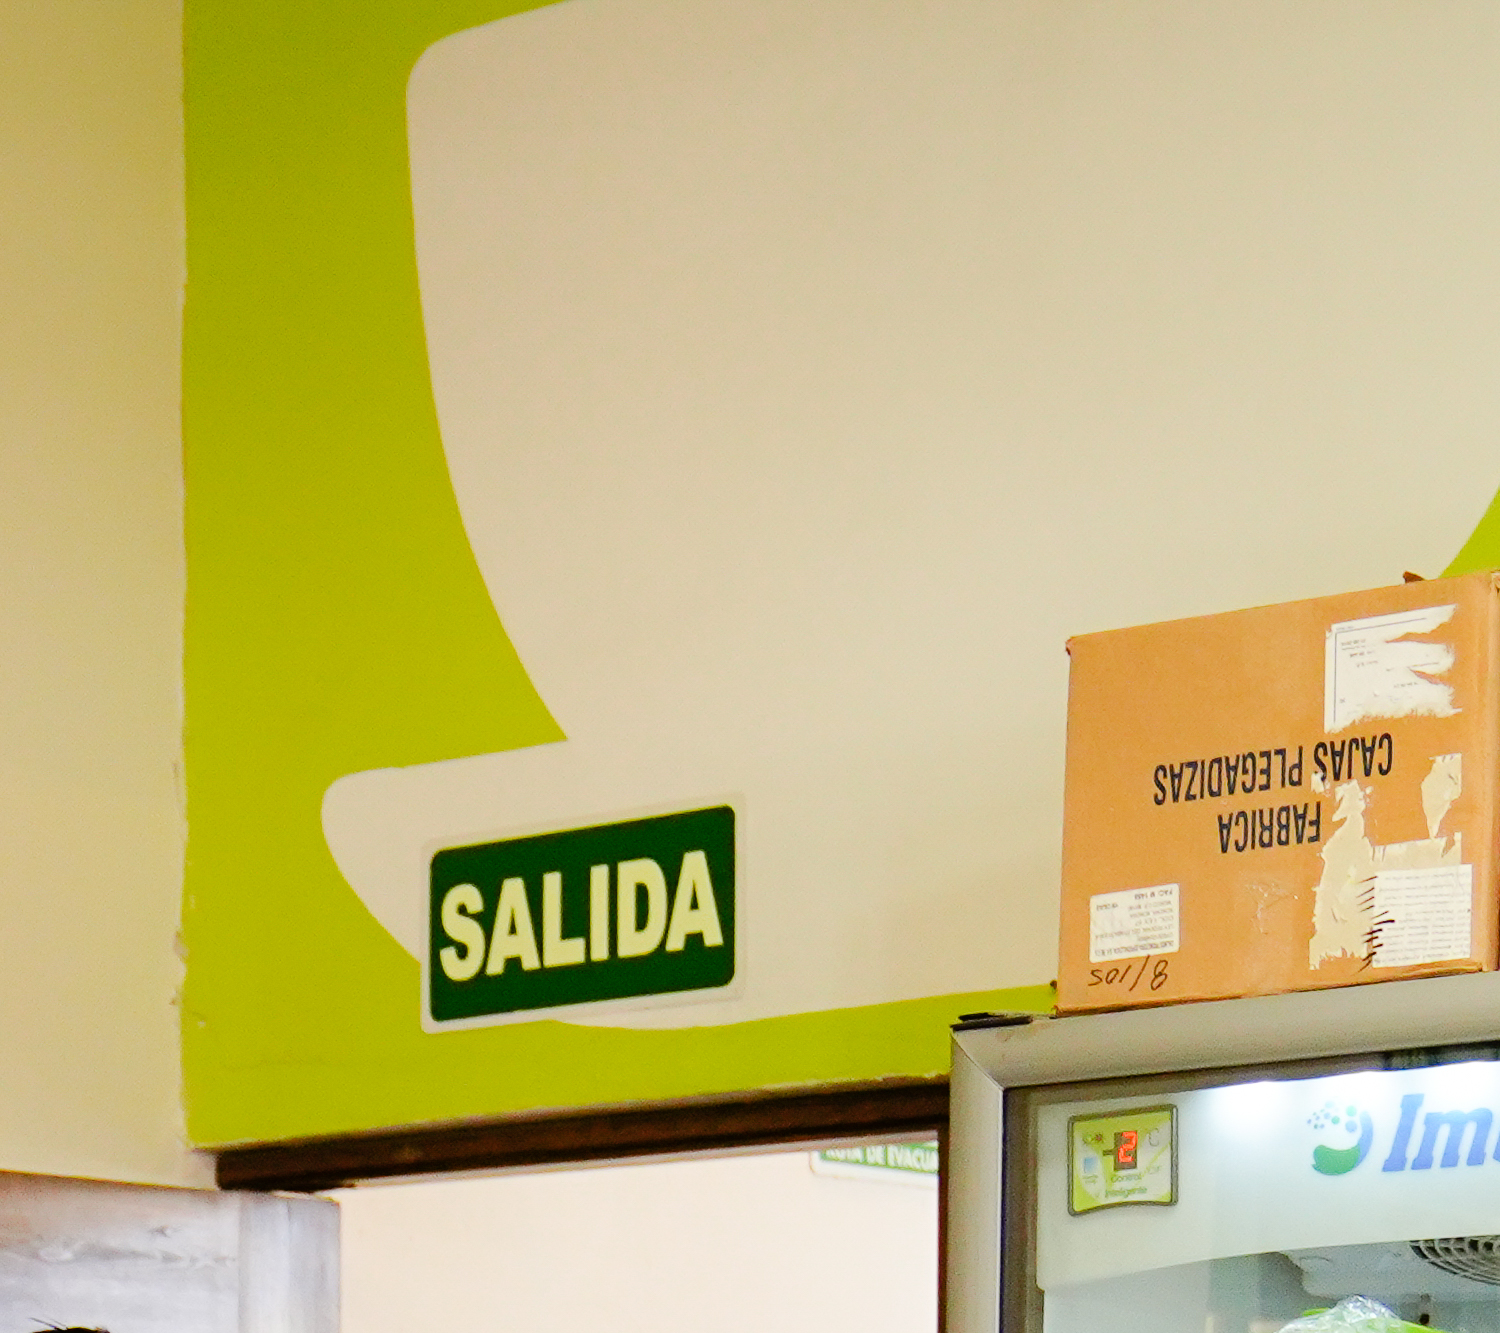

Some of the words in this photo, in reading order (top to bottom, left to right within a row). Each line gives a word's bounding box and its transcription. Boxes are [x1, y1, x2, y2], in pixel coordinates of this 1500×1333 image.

[1153, 745, 1303, 806] PLEGADIZAS
[1313, 732, 1393, 782] CAJAS
[1217, 800, 1322, 854] FABRICA
[439, 849, 724, 982] SALIDA
